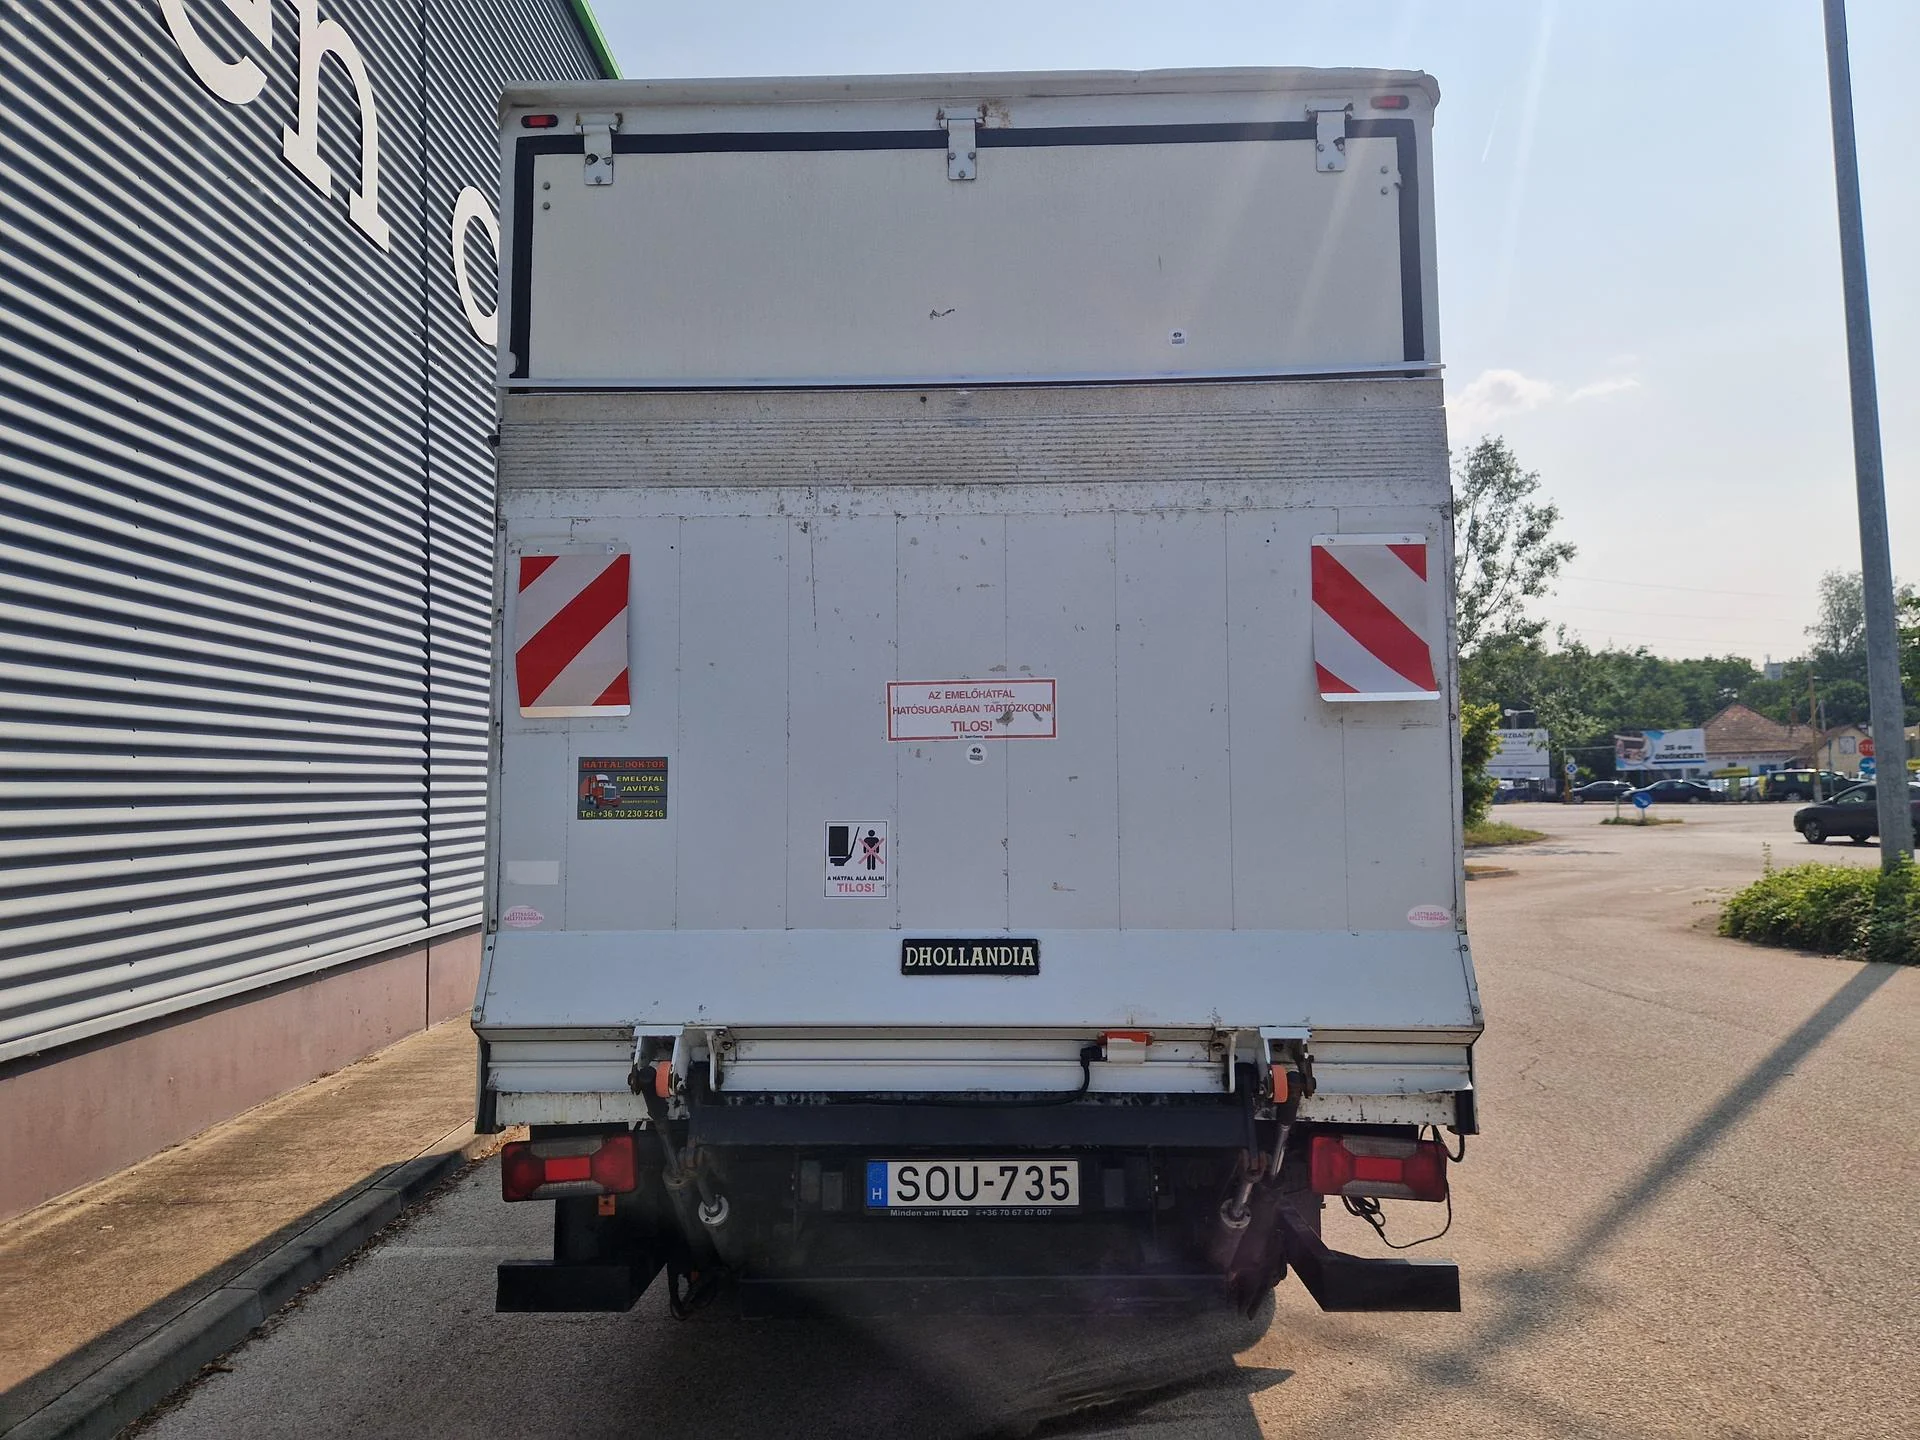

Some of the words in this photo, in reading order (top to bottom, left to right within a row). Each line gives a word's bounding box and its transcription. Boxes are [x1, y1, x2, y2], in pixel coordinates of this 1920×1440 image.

[928, 691, 941, 700] AZ
[892, 703, 980, 715] HATÓSUGARÁBAN
[984, 702, 1052, 713] TARTÓZKODNI
[951, 720, 993, 732] TILOS!
[624, 760, 665, 768] DOKTOR
[581, 810, 596, 818] Tel:
[598, 810, 613, 818] +36
[615, 810, 625, 818] 70
[627, 810, 642, 818] 230
[644, 810, 664, 818] 5216
[837, 883, 875, 892] TILOS!
[905, 947, 1035, 966] DHOLLANDIA
[872, 1188, 882, 1200] H
[896, 1166, 1070, 1201] SOU-735
